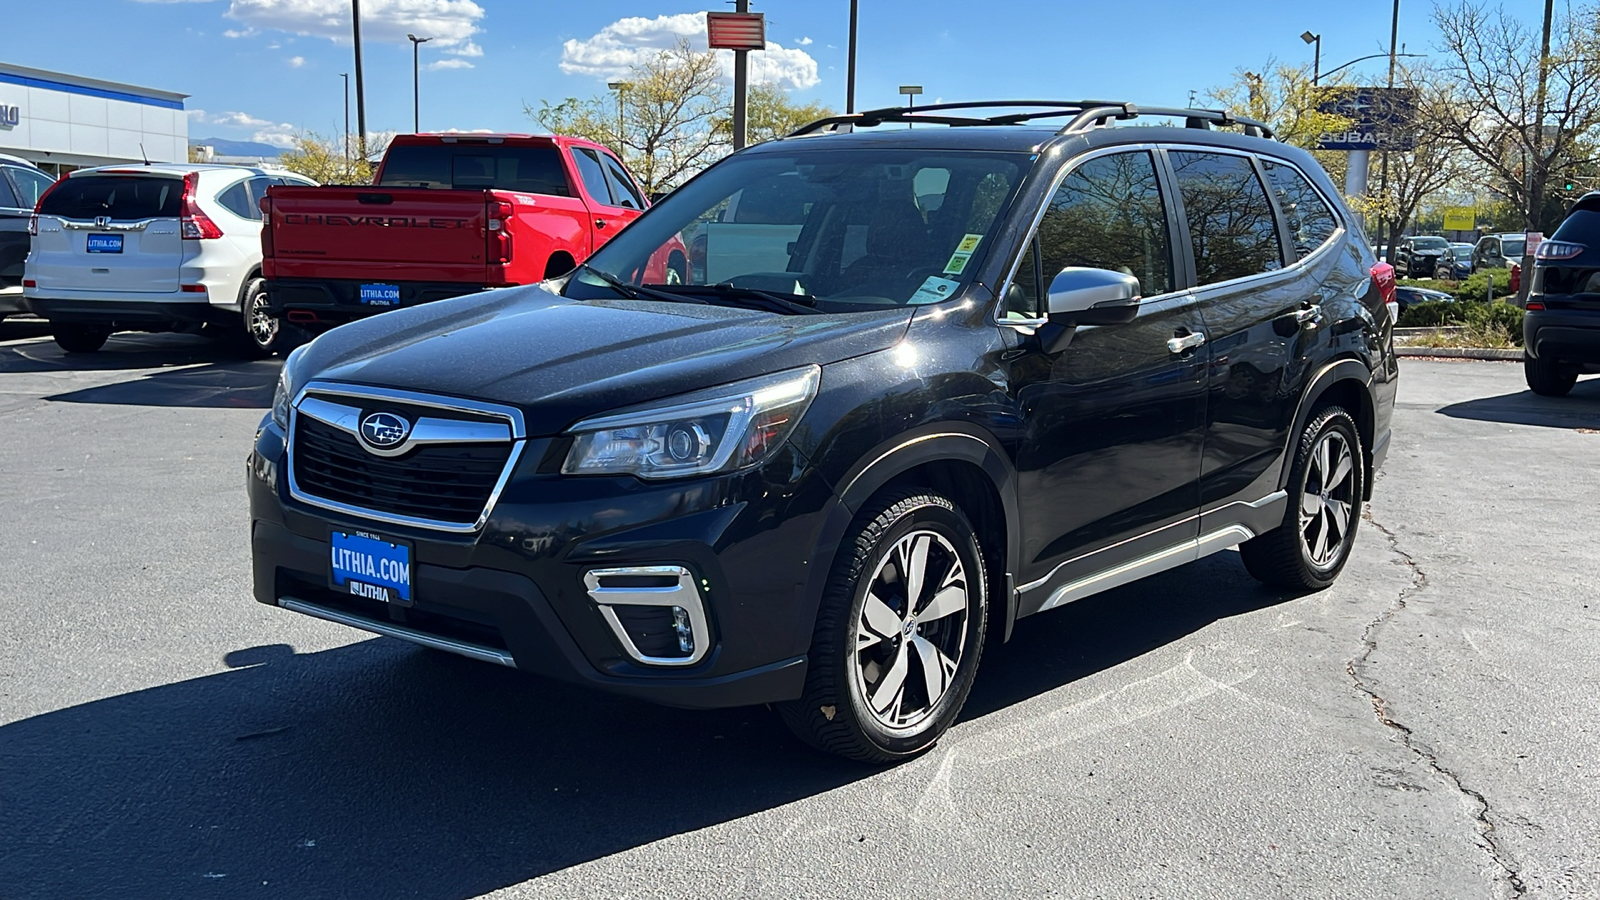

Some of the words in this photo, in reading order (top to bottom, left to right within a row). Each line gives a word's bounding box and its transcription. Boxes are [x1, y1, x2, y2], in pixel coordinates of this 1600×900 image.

[285, 214, 469, 229] CHEVROLET
[88, 239, 122, 248] LITHIA.COM
[360, 289, 400, 299] LITHIA.COM
[331, 546, 410, 586] LITHIA.COM
[359, 582, 390, 603] LITHIA
